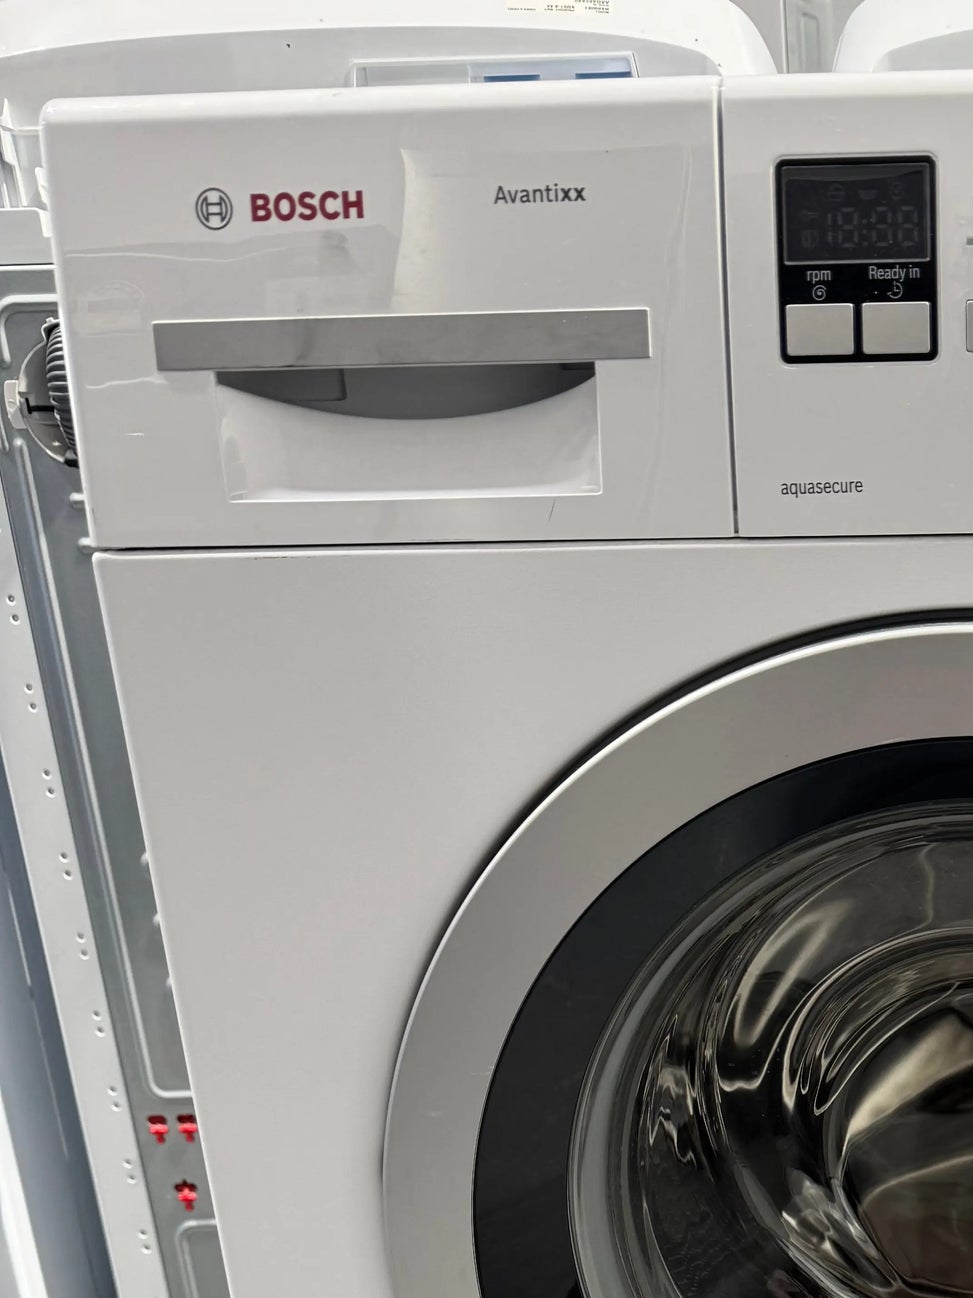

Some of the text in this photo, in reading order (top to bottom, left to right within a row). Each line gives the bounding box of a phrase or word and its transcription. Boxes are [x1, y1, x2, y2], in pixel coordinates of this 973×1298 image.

[494, 184, 586, 204] Avantixx
[250, 190, 365, 222] BOSCH
[806, 268, 832, 285] rpm
[868, 264, 921, 282] Ready in
[781, 480, 863, 498] aquasecure
